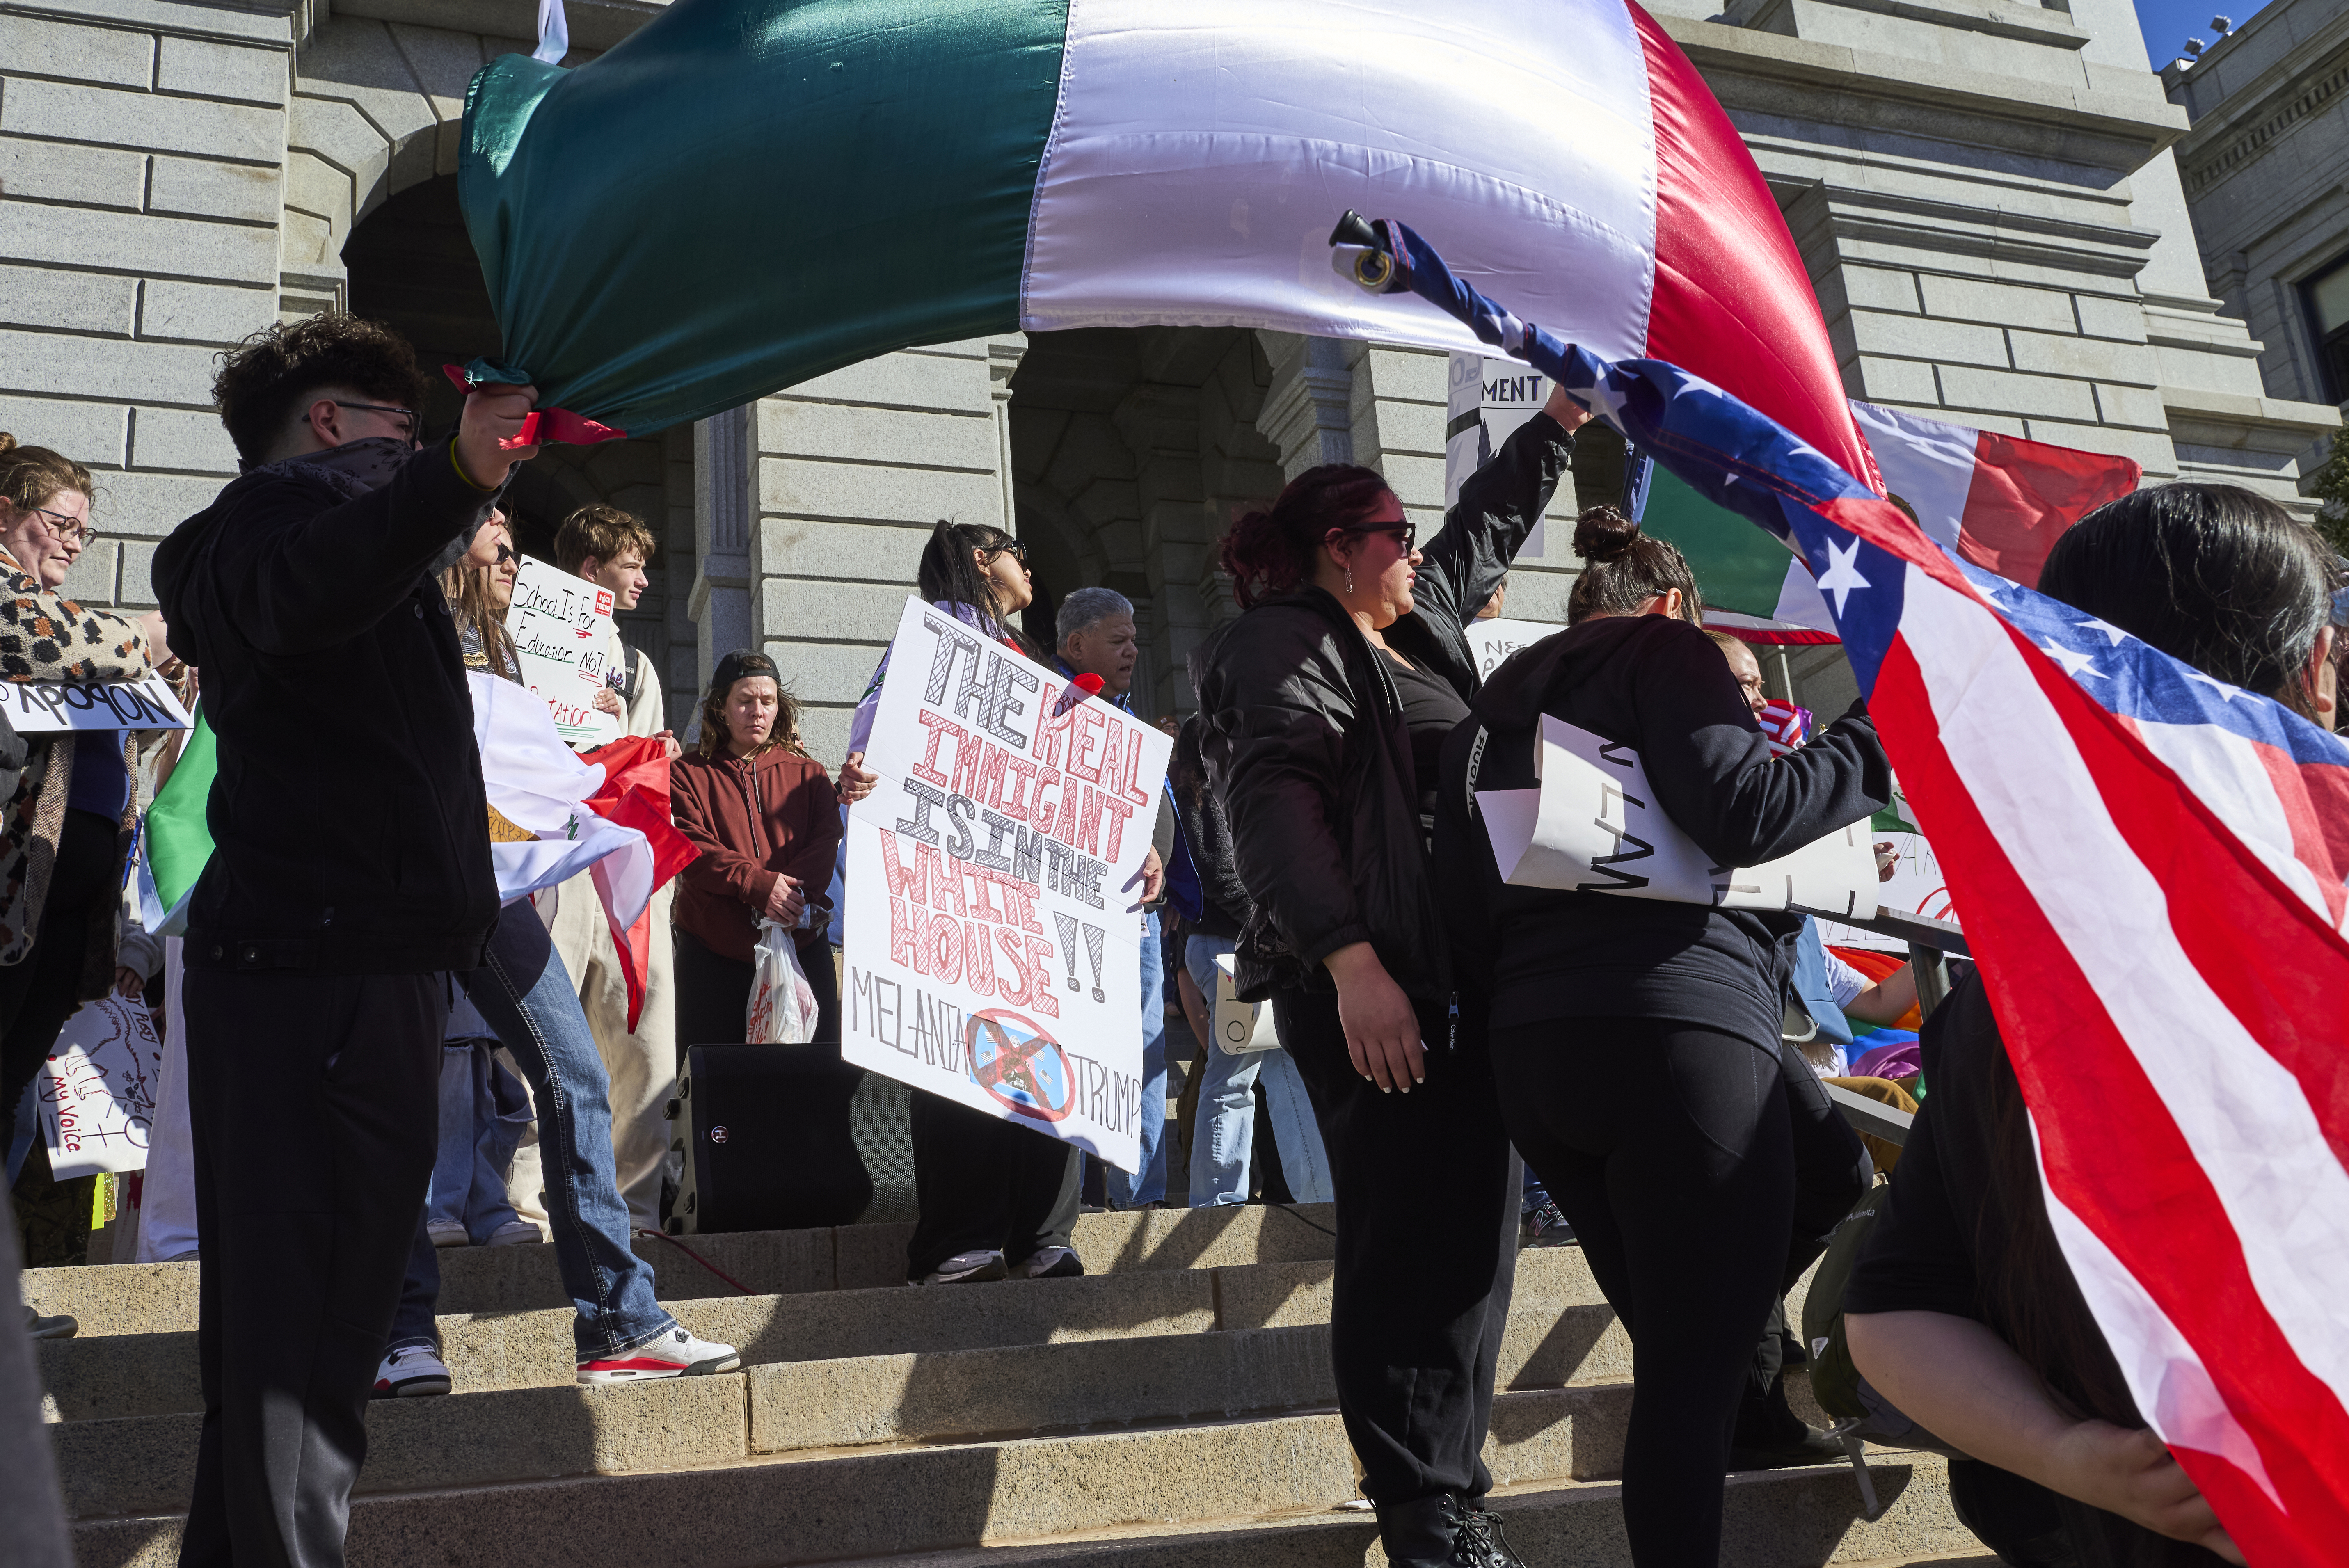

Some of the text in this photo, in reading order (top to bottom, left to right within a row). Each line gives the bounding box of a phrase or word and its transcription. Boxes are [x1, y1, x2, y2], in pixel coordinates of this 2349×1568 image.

[1482, 375, 1543, 402] MENT
[515, 610, 573, 663] Education
[558, 588, 574, 623] Is
[578, 596, 596, 631] For
[596, 602, 611, 612] TRUMP
[923, 611, 1148, 807] THE REAL
[912, 709, 1134, 864] IMMIGANT
[879, 828, 1044, 935] WHITE
[890, 896, 1059, 1018] HOUSE
[852, 966, 970, 1076] MELANIA
[1067, 1052, 1142, 1139] TRUMP
